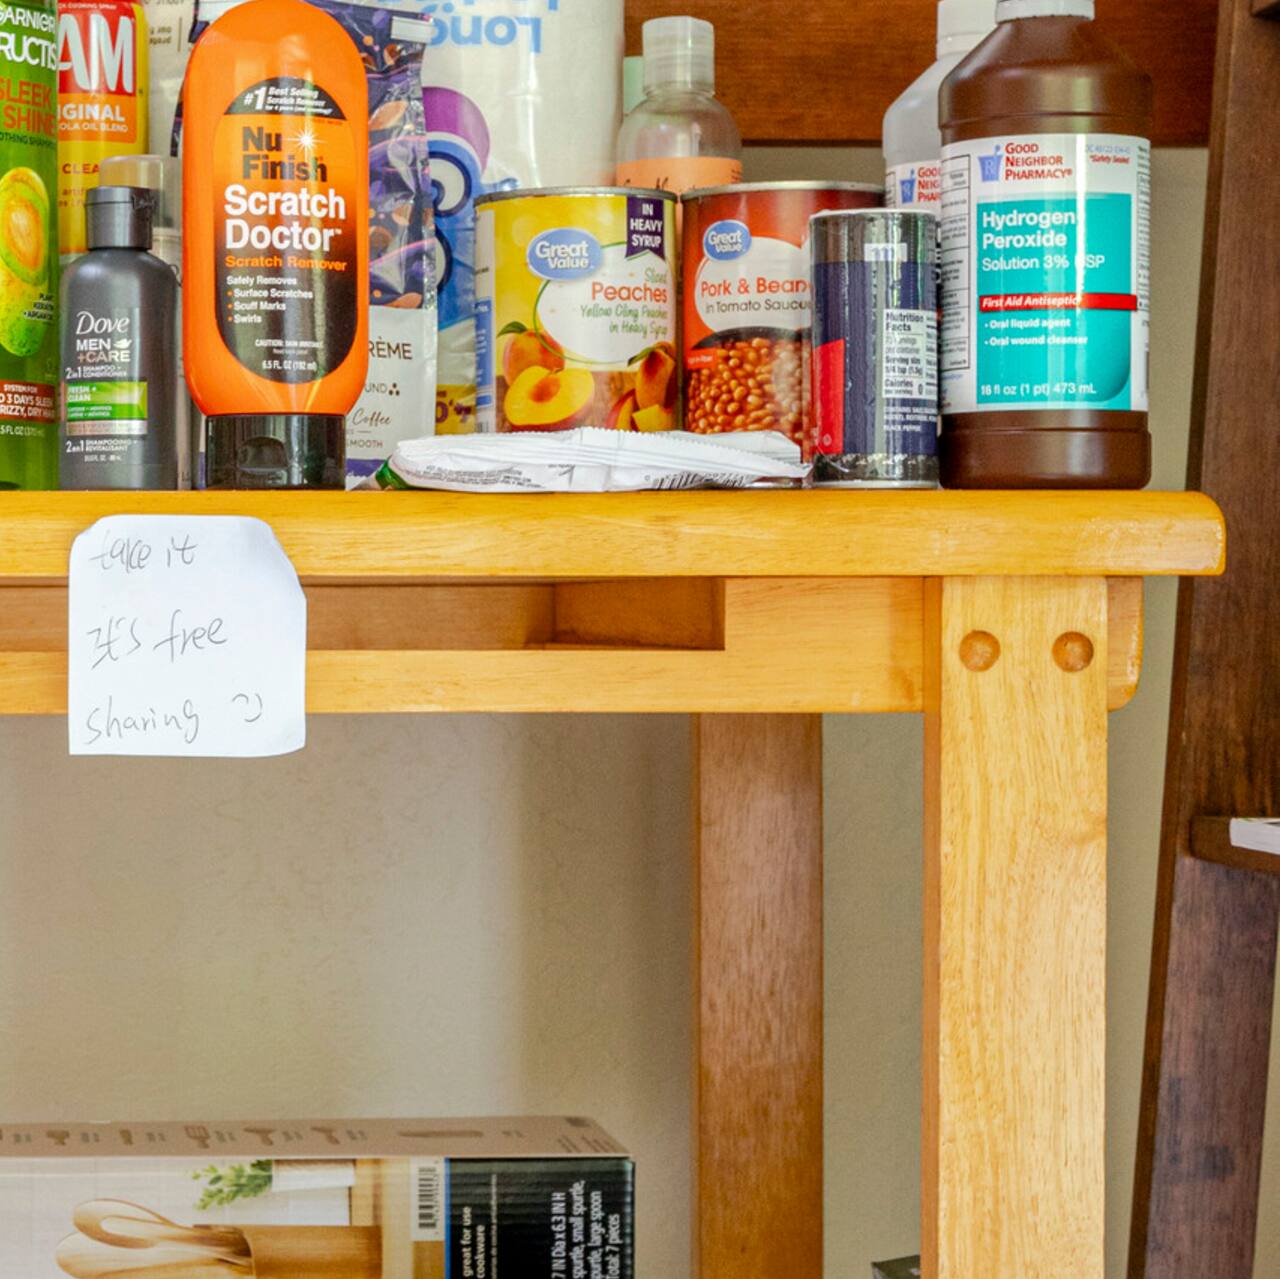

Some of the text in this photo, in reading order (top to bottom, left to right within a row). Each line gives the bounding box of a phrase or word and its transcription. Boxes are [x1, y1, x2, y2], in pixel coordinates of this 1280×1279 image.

[58, 13, 134, 94] AM
[4, 105, 55, 136] SHINE
[242, 126, 282, 152] Nu
[242, 154, 327, 182] Finish
[1005, 156, 1063, 167] NEIGHBOR
[224, 184, 346, 219] Scratch
[642, 204, 653, 215] IN
[630, 219, 663, 231] HEAVY
[982, 211, 1076, 231] Hydrogen
[631, 235, 661, 247] SYRUP
[708, 230, 742, 244] Great
[982, 232, 1067, 249] Peroxide
[535, 241, 589, 258] Great
[225, 256, 347, 271] Scratch Remover
[548, 258, 589, 269] Value
[982, 255, 1069, 271] Solution 3%
[226, 276, 297, 286] Safely Removes
[701, 277, 811, 298] Pork & Bean
[234, 288, 313, 299] Surface Scratches
[592, 282, 667, 302] Peaches
[717, 301, 761, 312] Tomato
[982, 295, 1082, 308] First Aid Antiseptic
[580, 304, 638, 320] Yellow Cling
[75, 310, 130, 335] Dove
[621, 321, 648, 338] Heavy
[886, 322, 911, 332] Facts
[989, 318, 1071, 330] Oral liquid agent
[76, 338, 111, 351] MEN
[368, 337, 413, 360] RÈME
[989, 336, 1088, 346] Oral wound cleanser
[77, 350, 131, 363] +CARE
[1003, 383, 1096, 395] oz 473 mL
[7, 394, 13, 403] 3
[352, 408, 392, 427] Coffee
[166, 534, 198, 567] it
[153, 609, 227, 662] free
[84, 695, 200, 744] sharing
[590, 1191, 603, 1221] spoon
[462, 1229, 471, 1245] for
[570, 1180, 585, 1279] spurtle, small spurtle,
[588, 1222, 603, 1246] large
[605, 1214, 620, 1244] pieces
[476, 1225, 485, 1279] cookware
[463, 1247, 473, 1276] great
